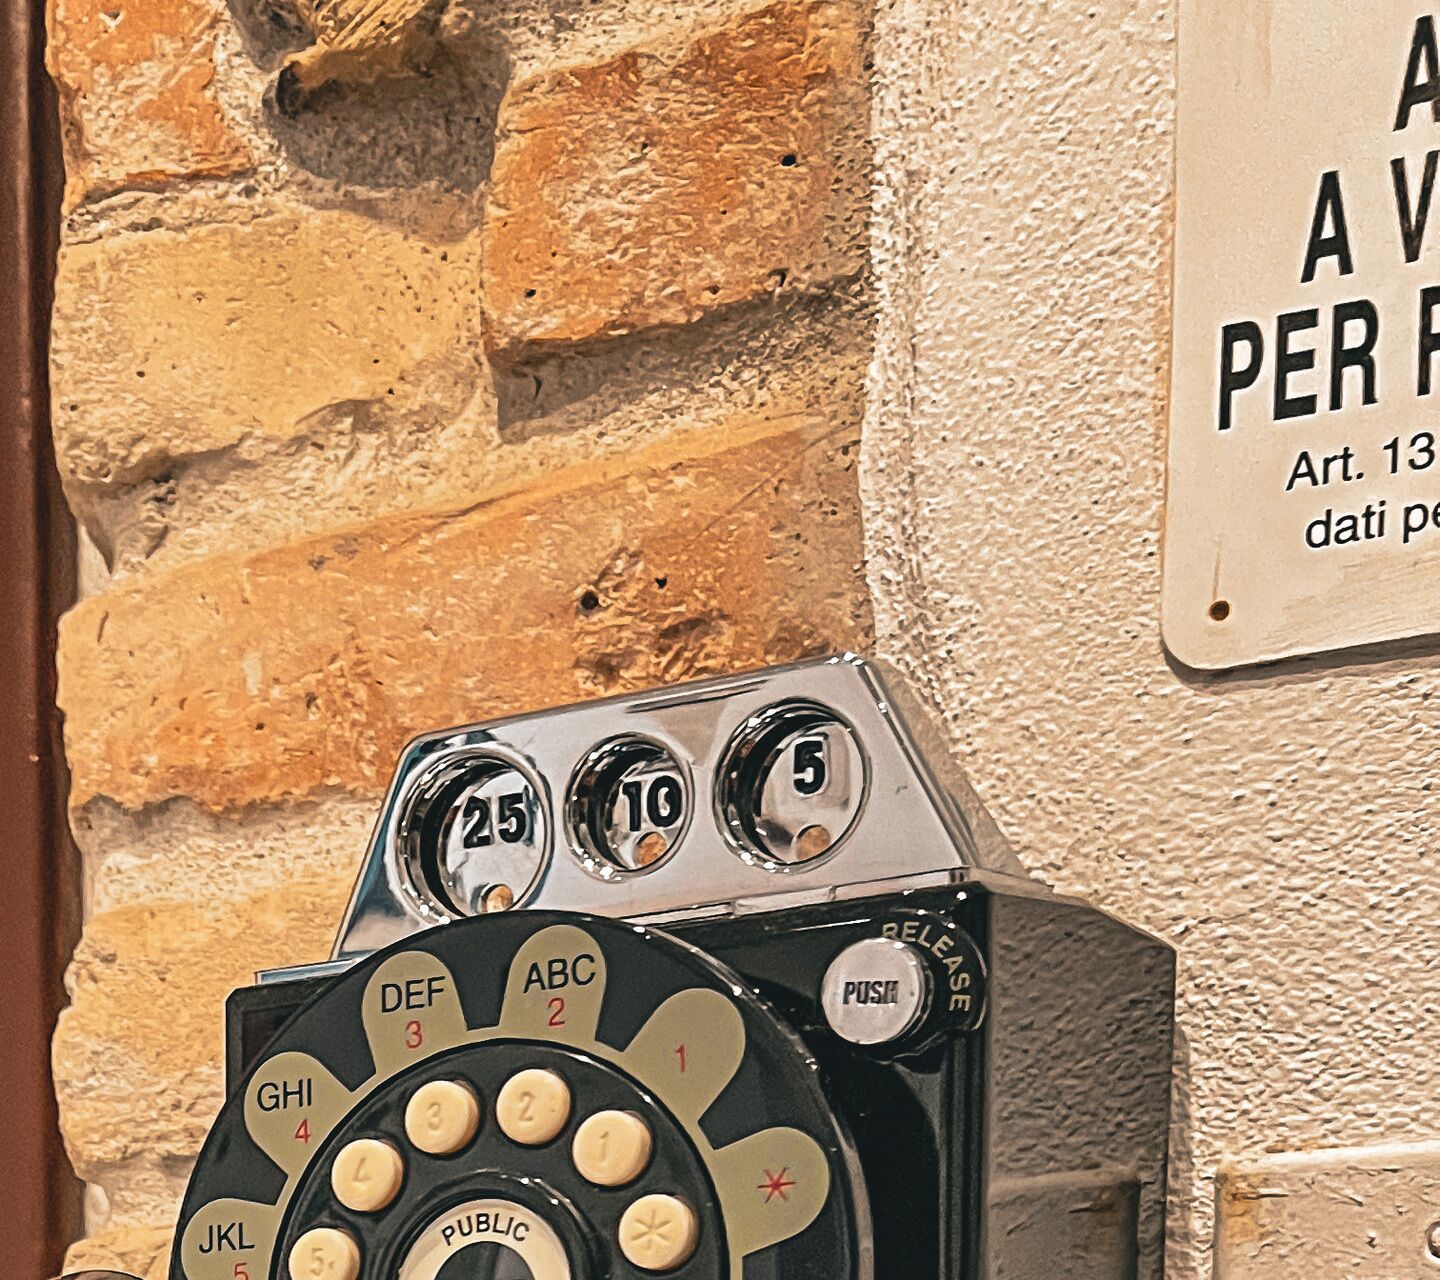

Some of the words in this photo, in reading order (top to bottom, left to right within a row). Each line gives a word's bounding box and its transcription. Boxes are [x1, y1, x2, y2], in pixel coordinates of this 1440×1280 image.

[1300, 170, 1354, 283] A
[1390, 150, 1440, 263] V
[1218, 299, 1379, 430] PER
[1285, 446, 1364, 491] Art.
[1383, 431, 1436, 475] 13
[1306, 500, 1386, 548] dati
[792, 740, 827, 795] 5
[462, 793, 527, 848] 25
[621, 775, 682, 831] 10
[523, 953, 596, 994] ABC
[882, 921, 971, 1012] RELEASE
[380, 977, 446, 1014] DEF
[843, 979, 899, 1006] PUSH
[549, 999, 566, 1027] 2
[405, 1021, 423, 1049] 3
[675, 1045, 687, 1073] 1
[256, 1076, 313, 1112] GHI
[294, 1119, 312, 1145] 4
[199, 1224, 255, 1254] JKL
[441, 1212, 531, 1247] PUBLIC
